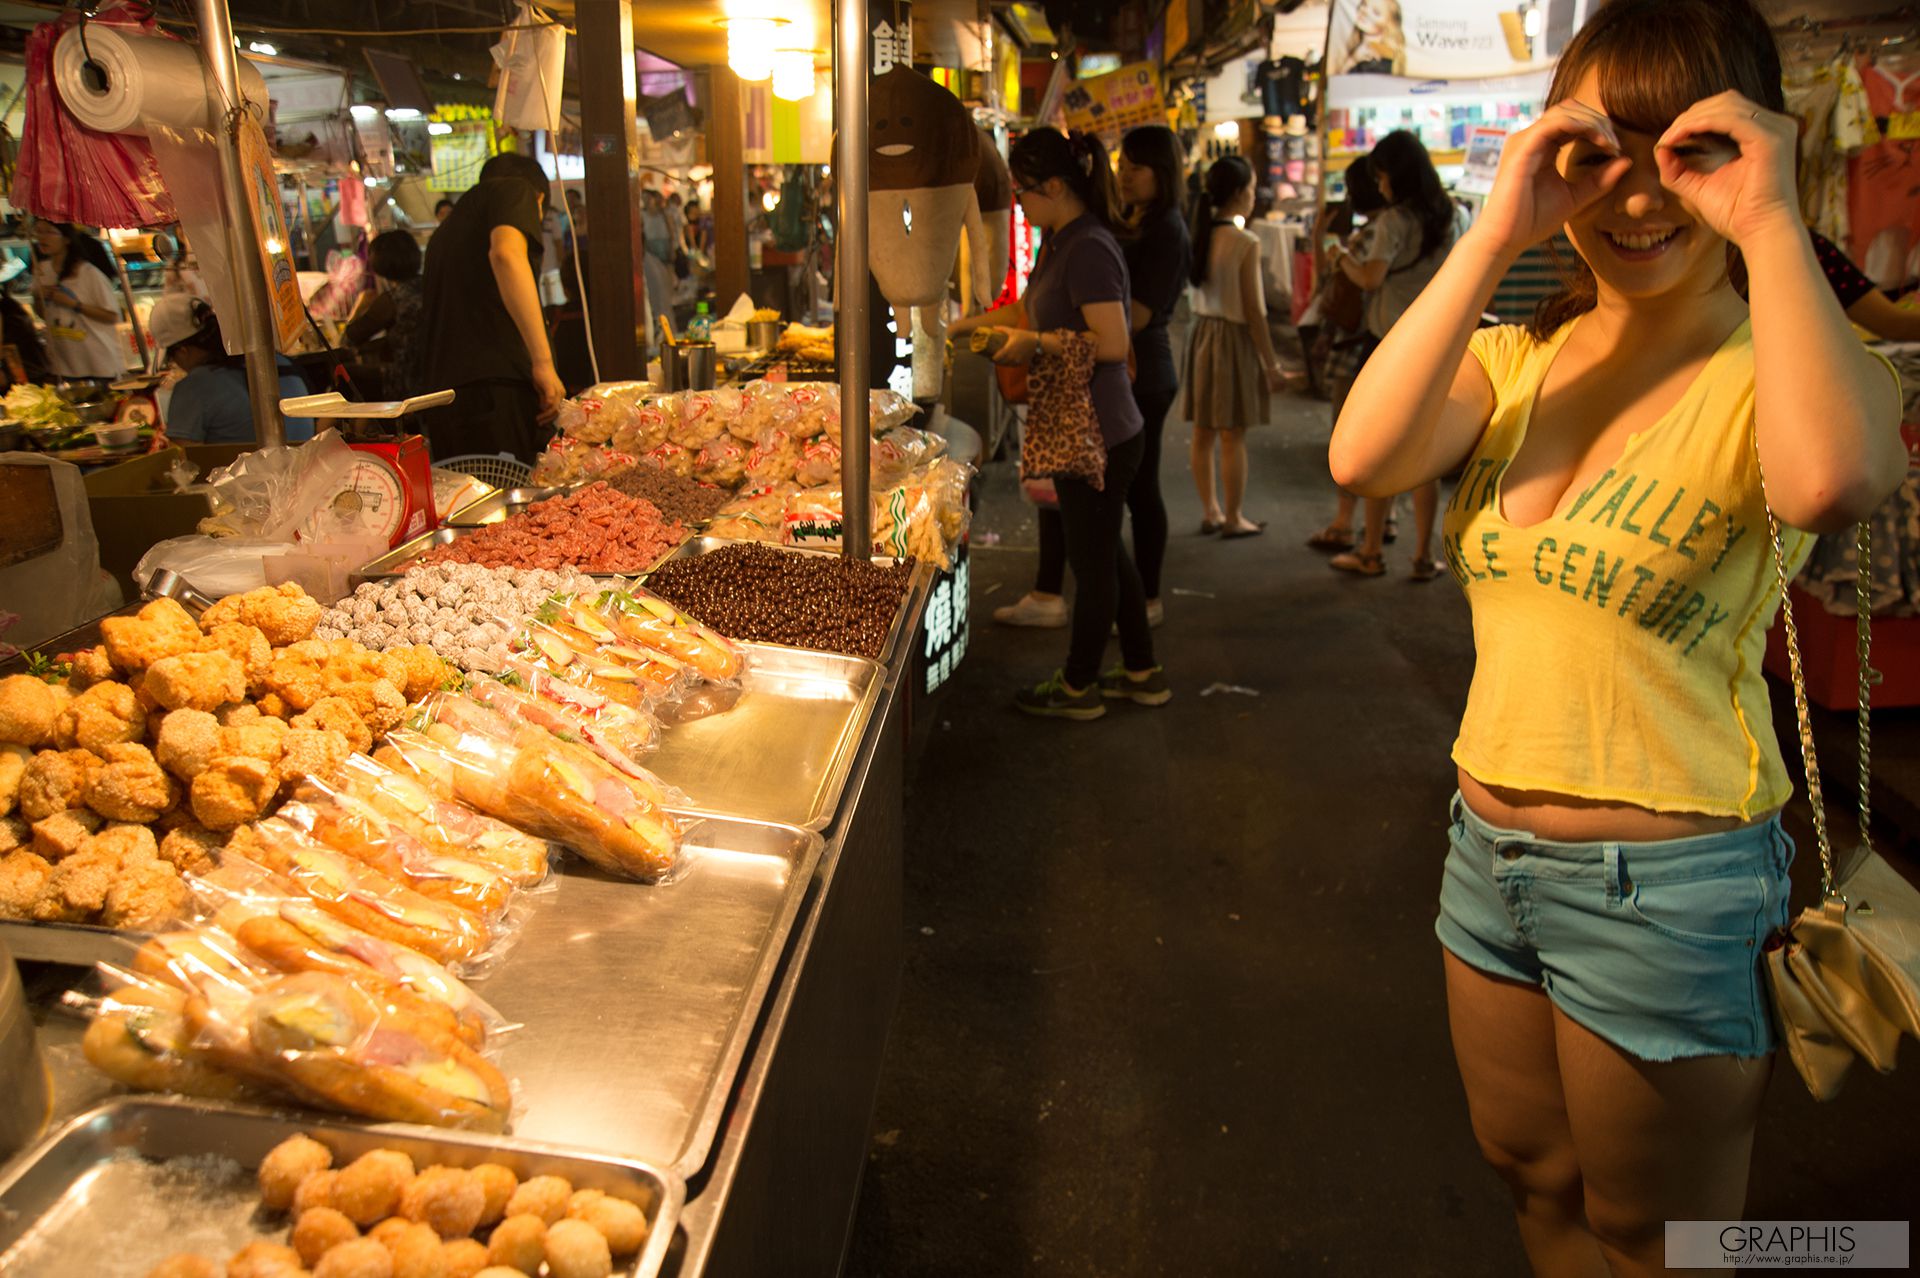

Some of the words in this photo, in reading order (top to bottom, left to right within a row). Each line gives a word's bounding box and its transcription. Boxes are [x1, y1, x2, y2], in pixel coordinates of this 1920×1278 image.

[1416, 32, 1468, 48] Wave
[1565, 468, 1747, 574] VALLEY
[1533, 537, 1729, 656] CENTURY
